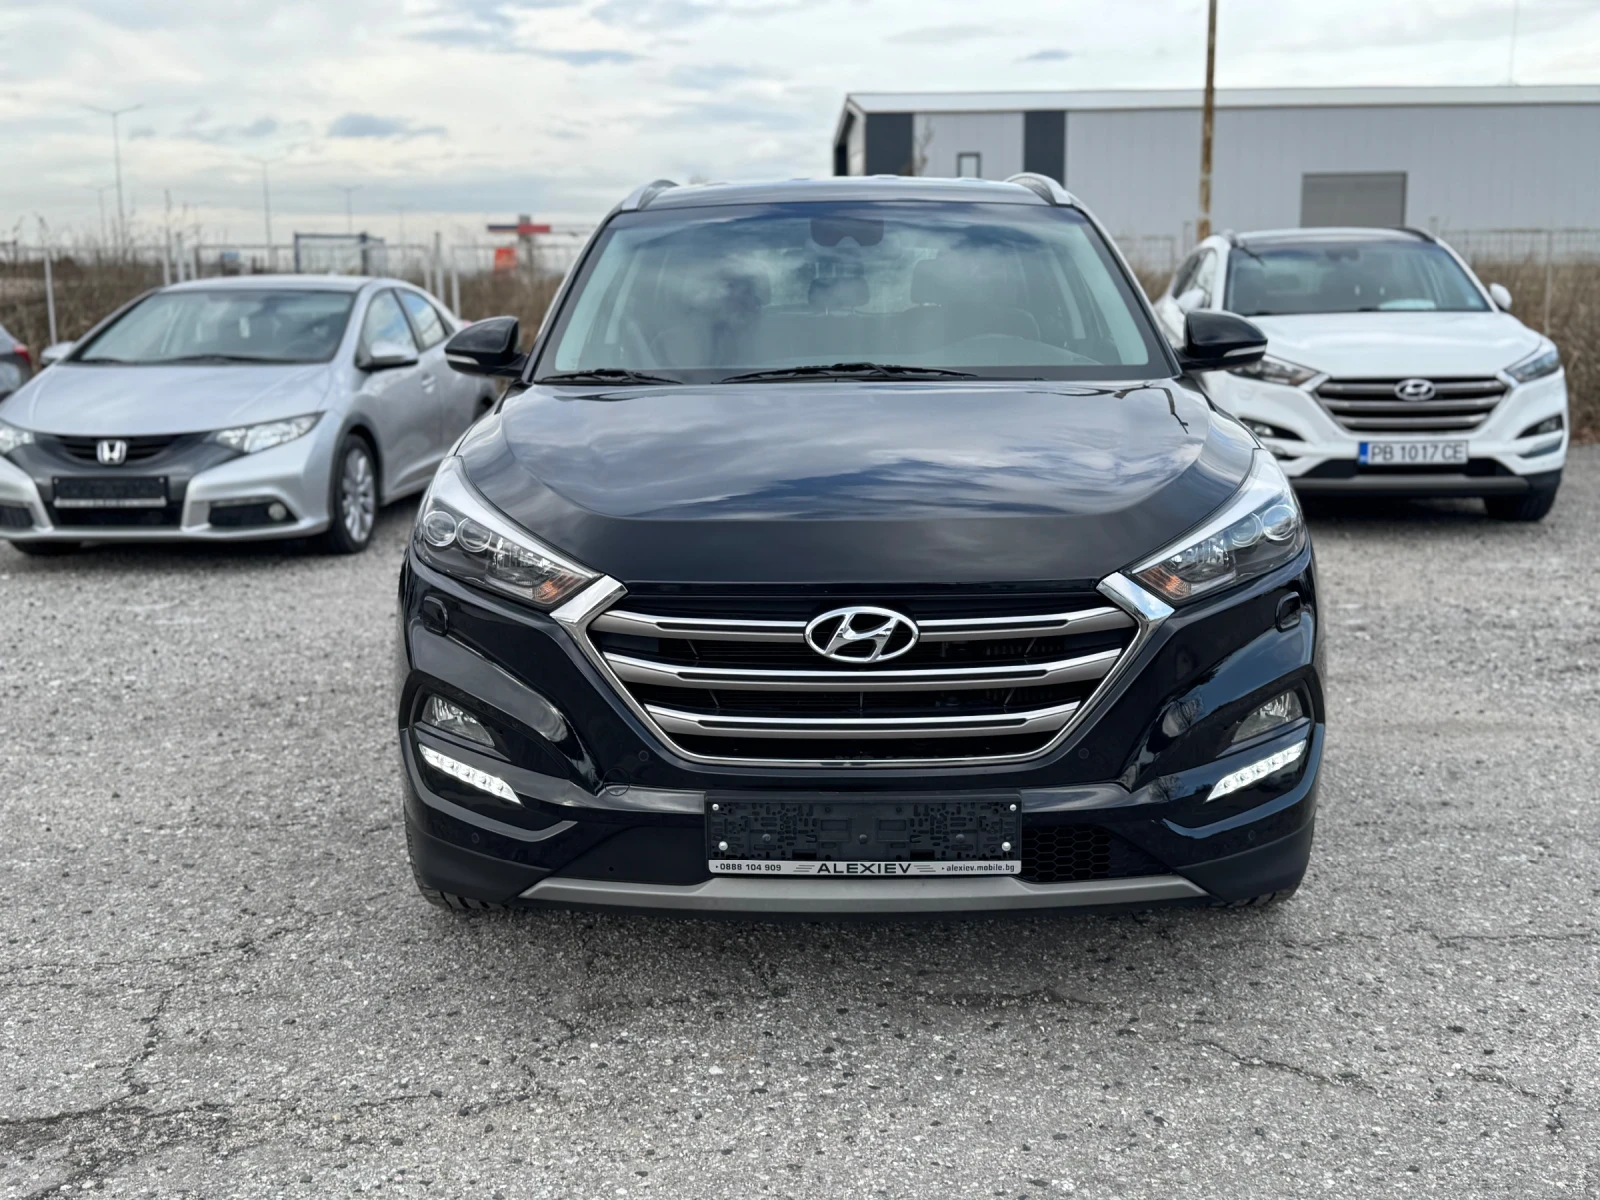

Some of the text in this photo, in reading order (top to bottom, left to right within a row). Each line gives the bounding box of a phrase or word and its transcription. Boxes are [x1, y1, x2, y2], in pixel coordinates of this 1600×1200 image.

[1371, 443, 1463, 461] PB 1017 CE
[720, 863, 782, 872] 0888 104 909
[817, 863, 911, 874] ALEXIEV
[946, 863, 1015, 873] alexiev.mobile.bg
